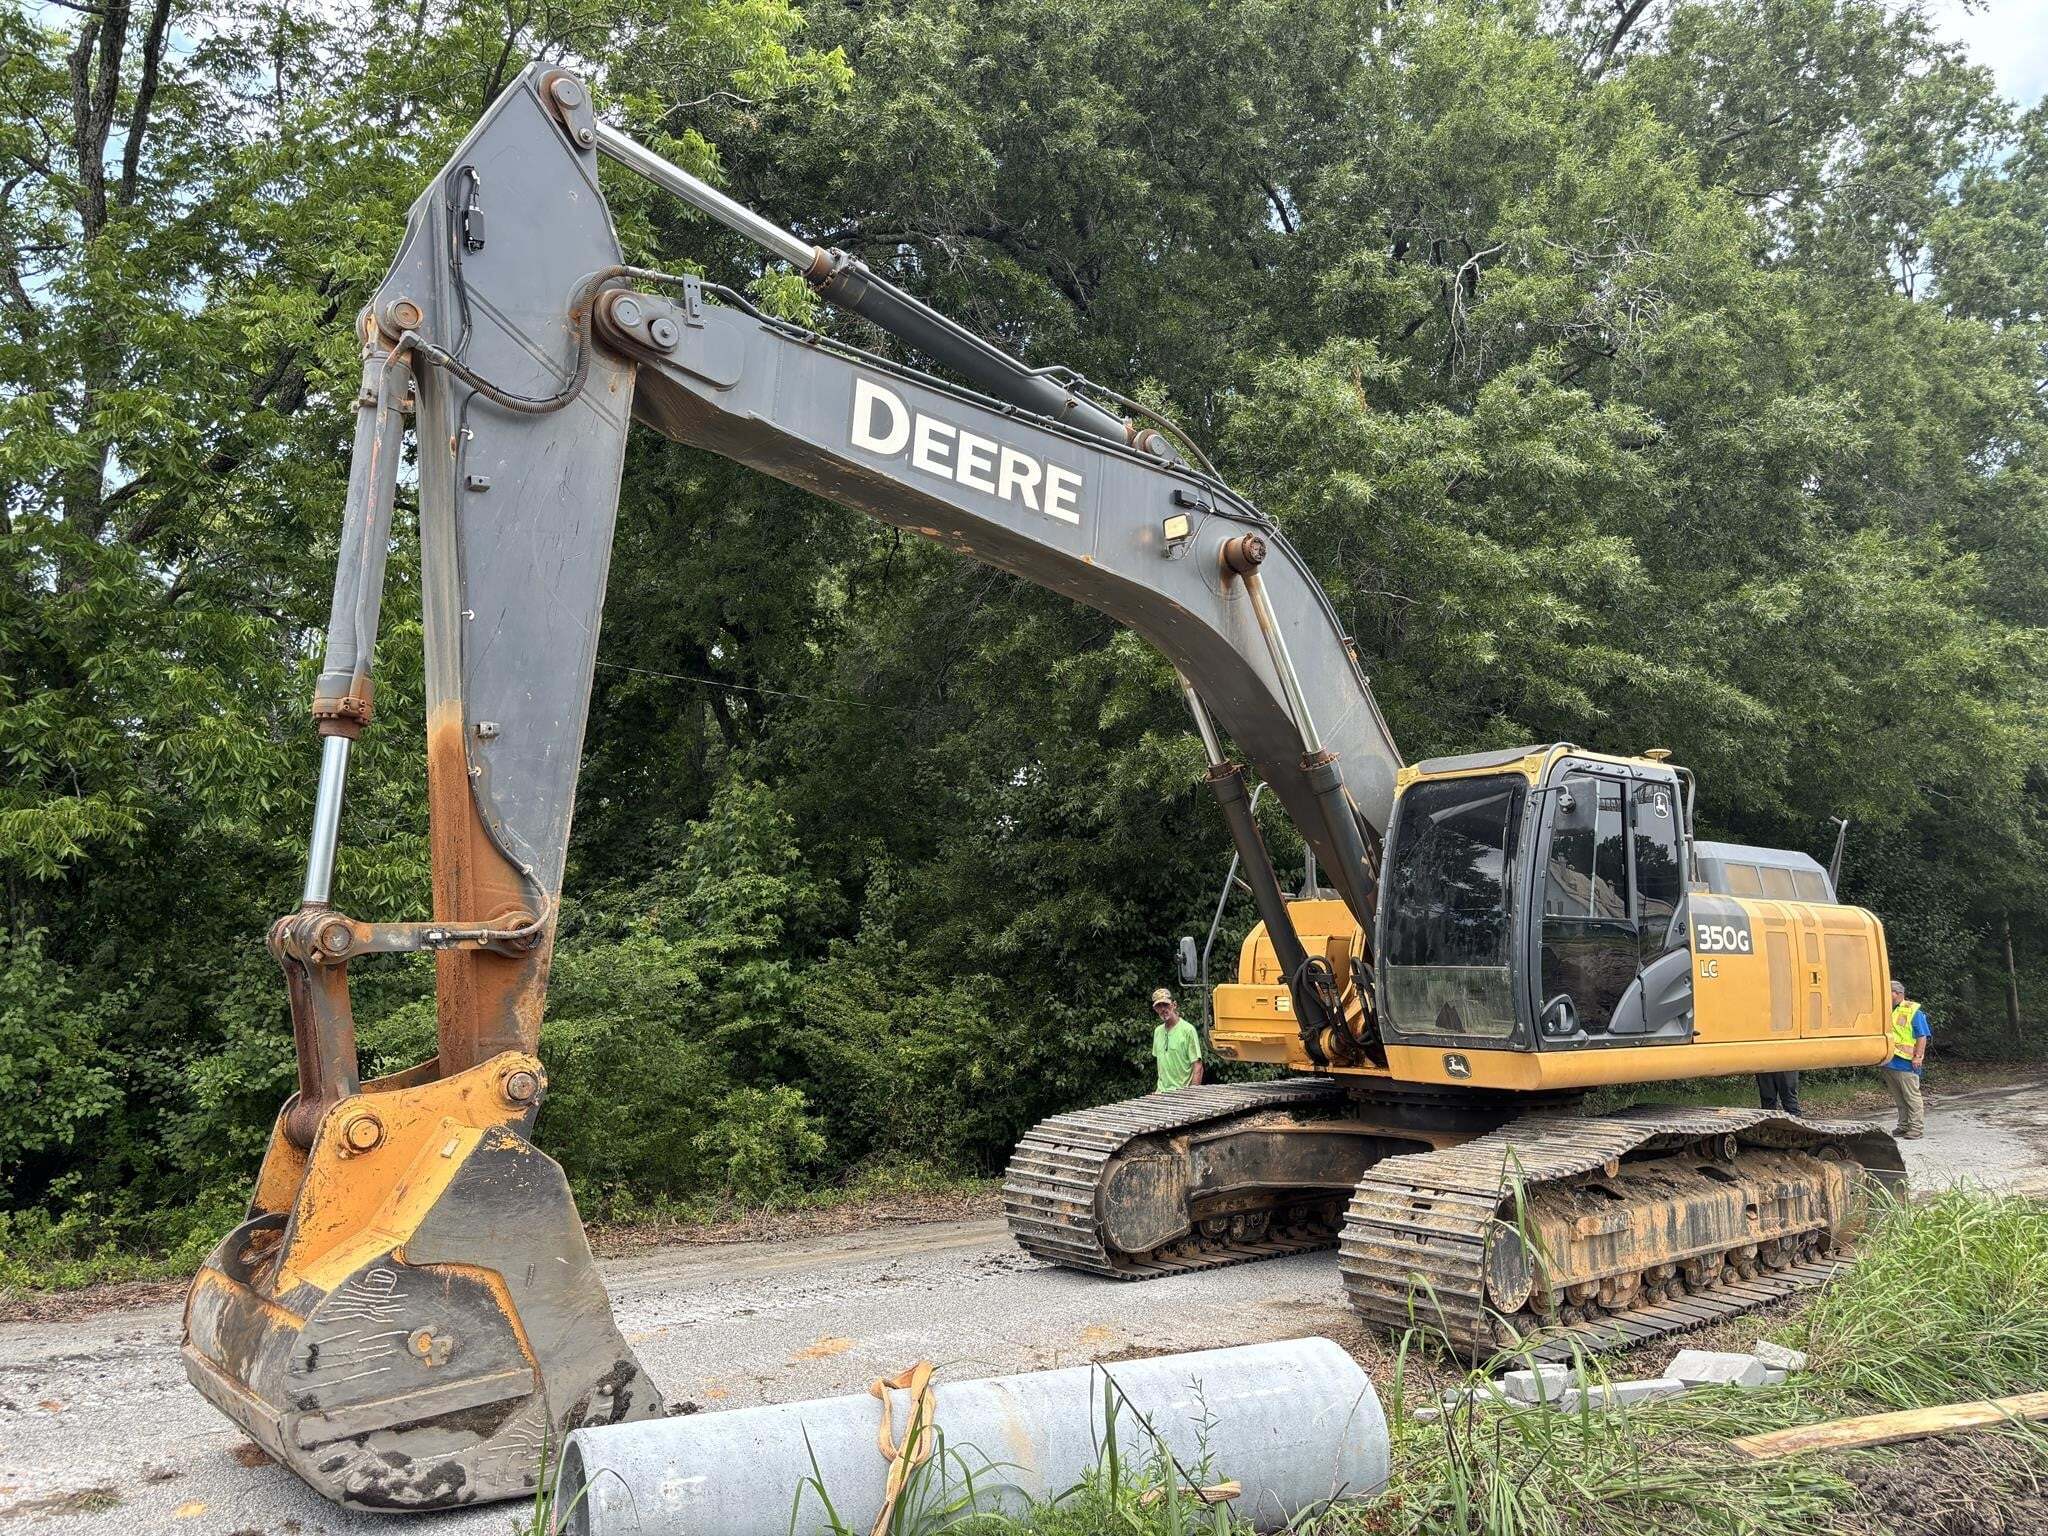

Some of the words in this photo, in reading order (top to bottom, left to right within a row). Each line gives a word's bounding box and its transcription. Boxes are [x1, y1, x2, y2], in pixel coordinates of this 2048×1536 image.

[851, 377, 1083, 525] DEERE
[1698, 924, 1749, 951] 350G
[1700, 960, 1718, 978] LC
